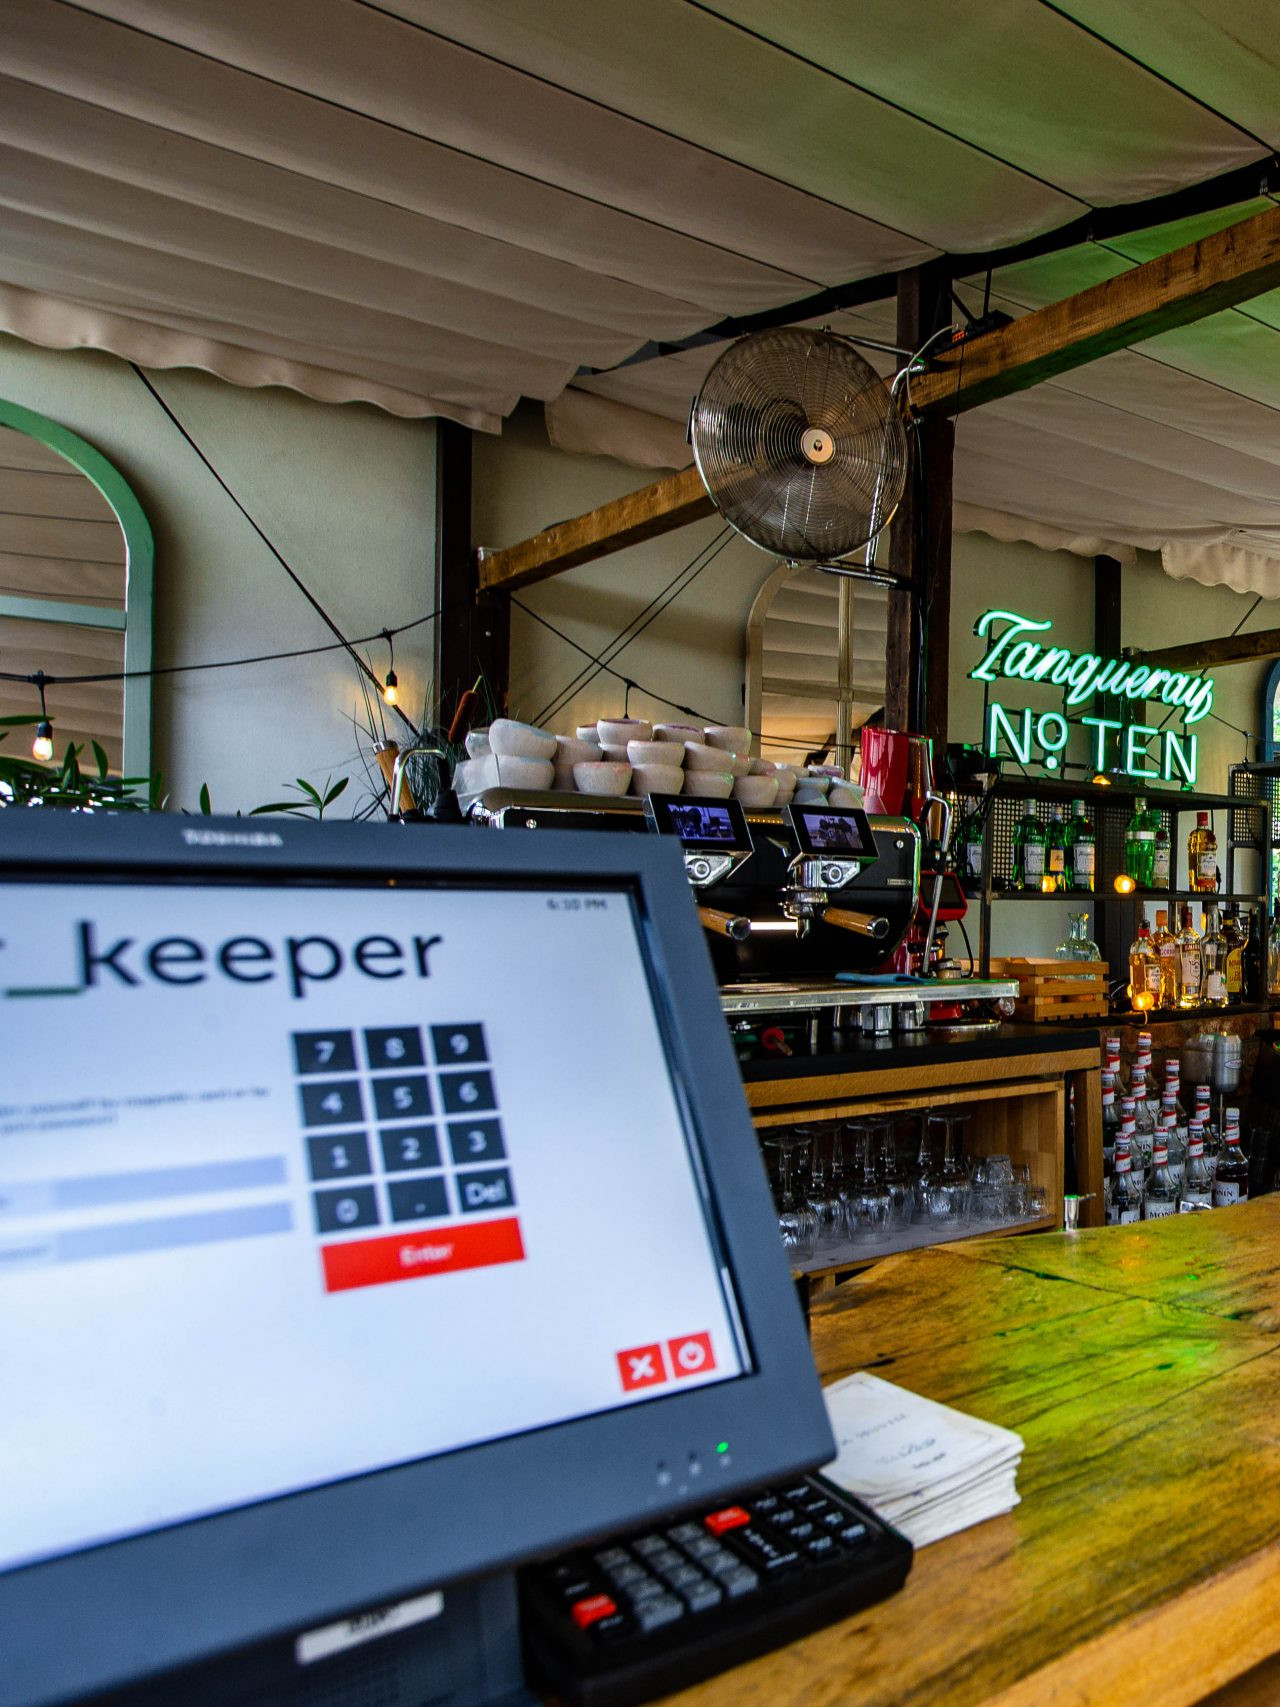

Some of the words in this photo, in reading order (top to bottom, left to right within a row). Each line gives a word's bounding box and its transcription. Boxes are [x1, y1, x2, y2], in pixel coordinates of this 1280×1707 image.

[971, 610, 1214, 724] Tanqueray
[1082, 716, 1197, 784] TEN
[0, 919, 443, 998] _keeper
[315, 1040, 335, 1063] 7
[384, 1036, 405, 1059] 8
[450, 1033, 469, 1055] 9
[321, 1092, 343, 1115] 4
[393, 1085, 413, 1109] 5
[459, 1081, 478, 1103] 6
[331, 1145, 349, 1169] 1
[402, 1136, 421, 1161] 2
[467, 1130, 487, 1153] 3
[336, 1198, 359, 1223] 0
[465, 1178, 507, 1206] Del
[400, 1243, 454, 1267] Enter
